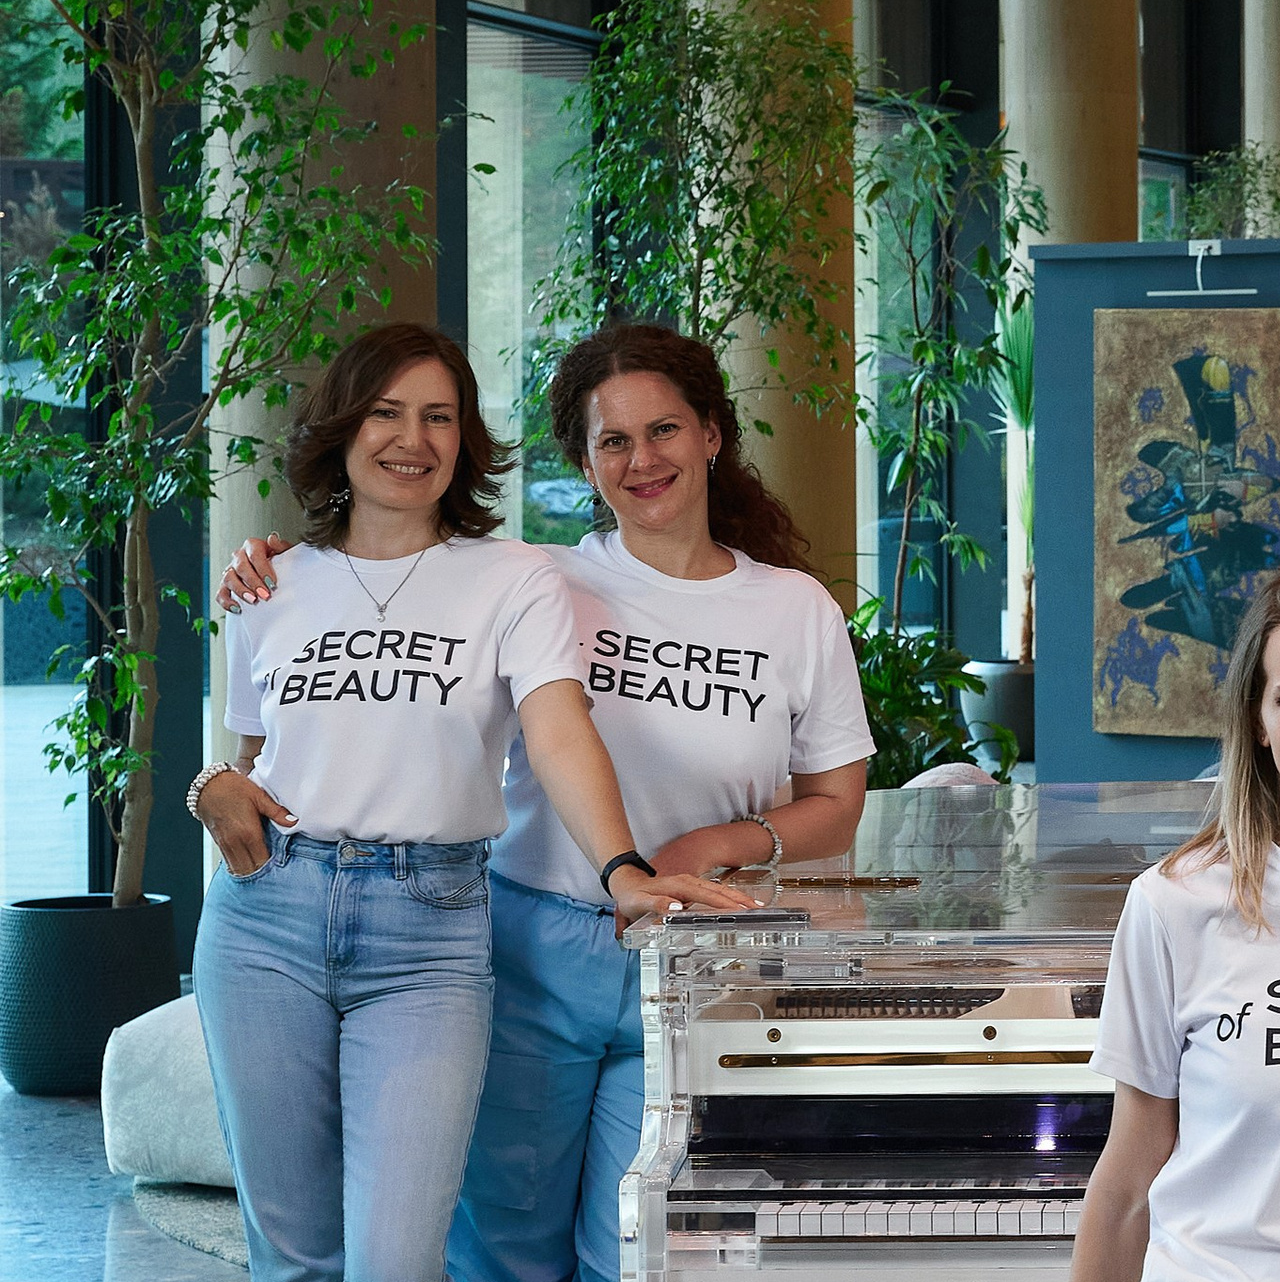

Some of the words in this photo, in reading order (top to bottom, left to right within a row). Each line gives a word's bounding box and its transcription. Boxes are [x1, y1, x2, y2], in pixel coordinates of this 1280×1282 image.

[291, 629, 467, 666] SECRET
[592, 629, 769, 681] SECRET
[279, 669, 463, 706] BEAUTY
[588, 661, 767, 723] BEAUTY
[1216, 1002, 1254, 1042] of
